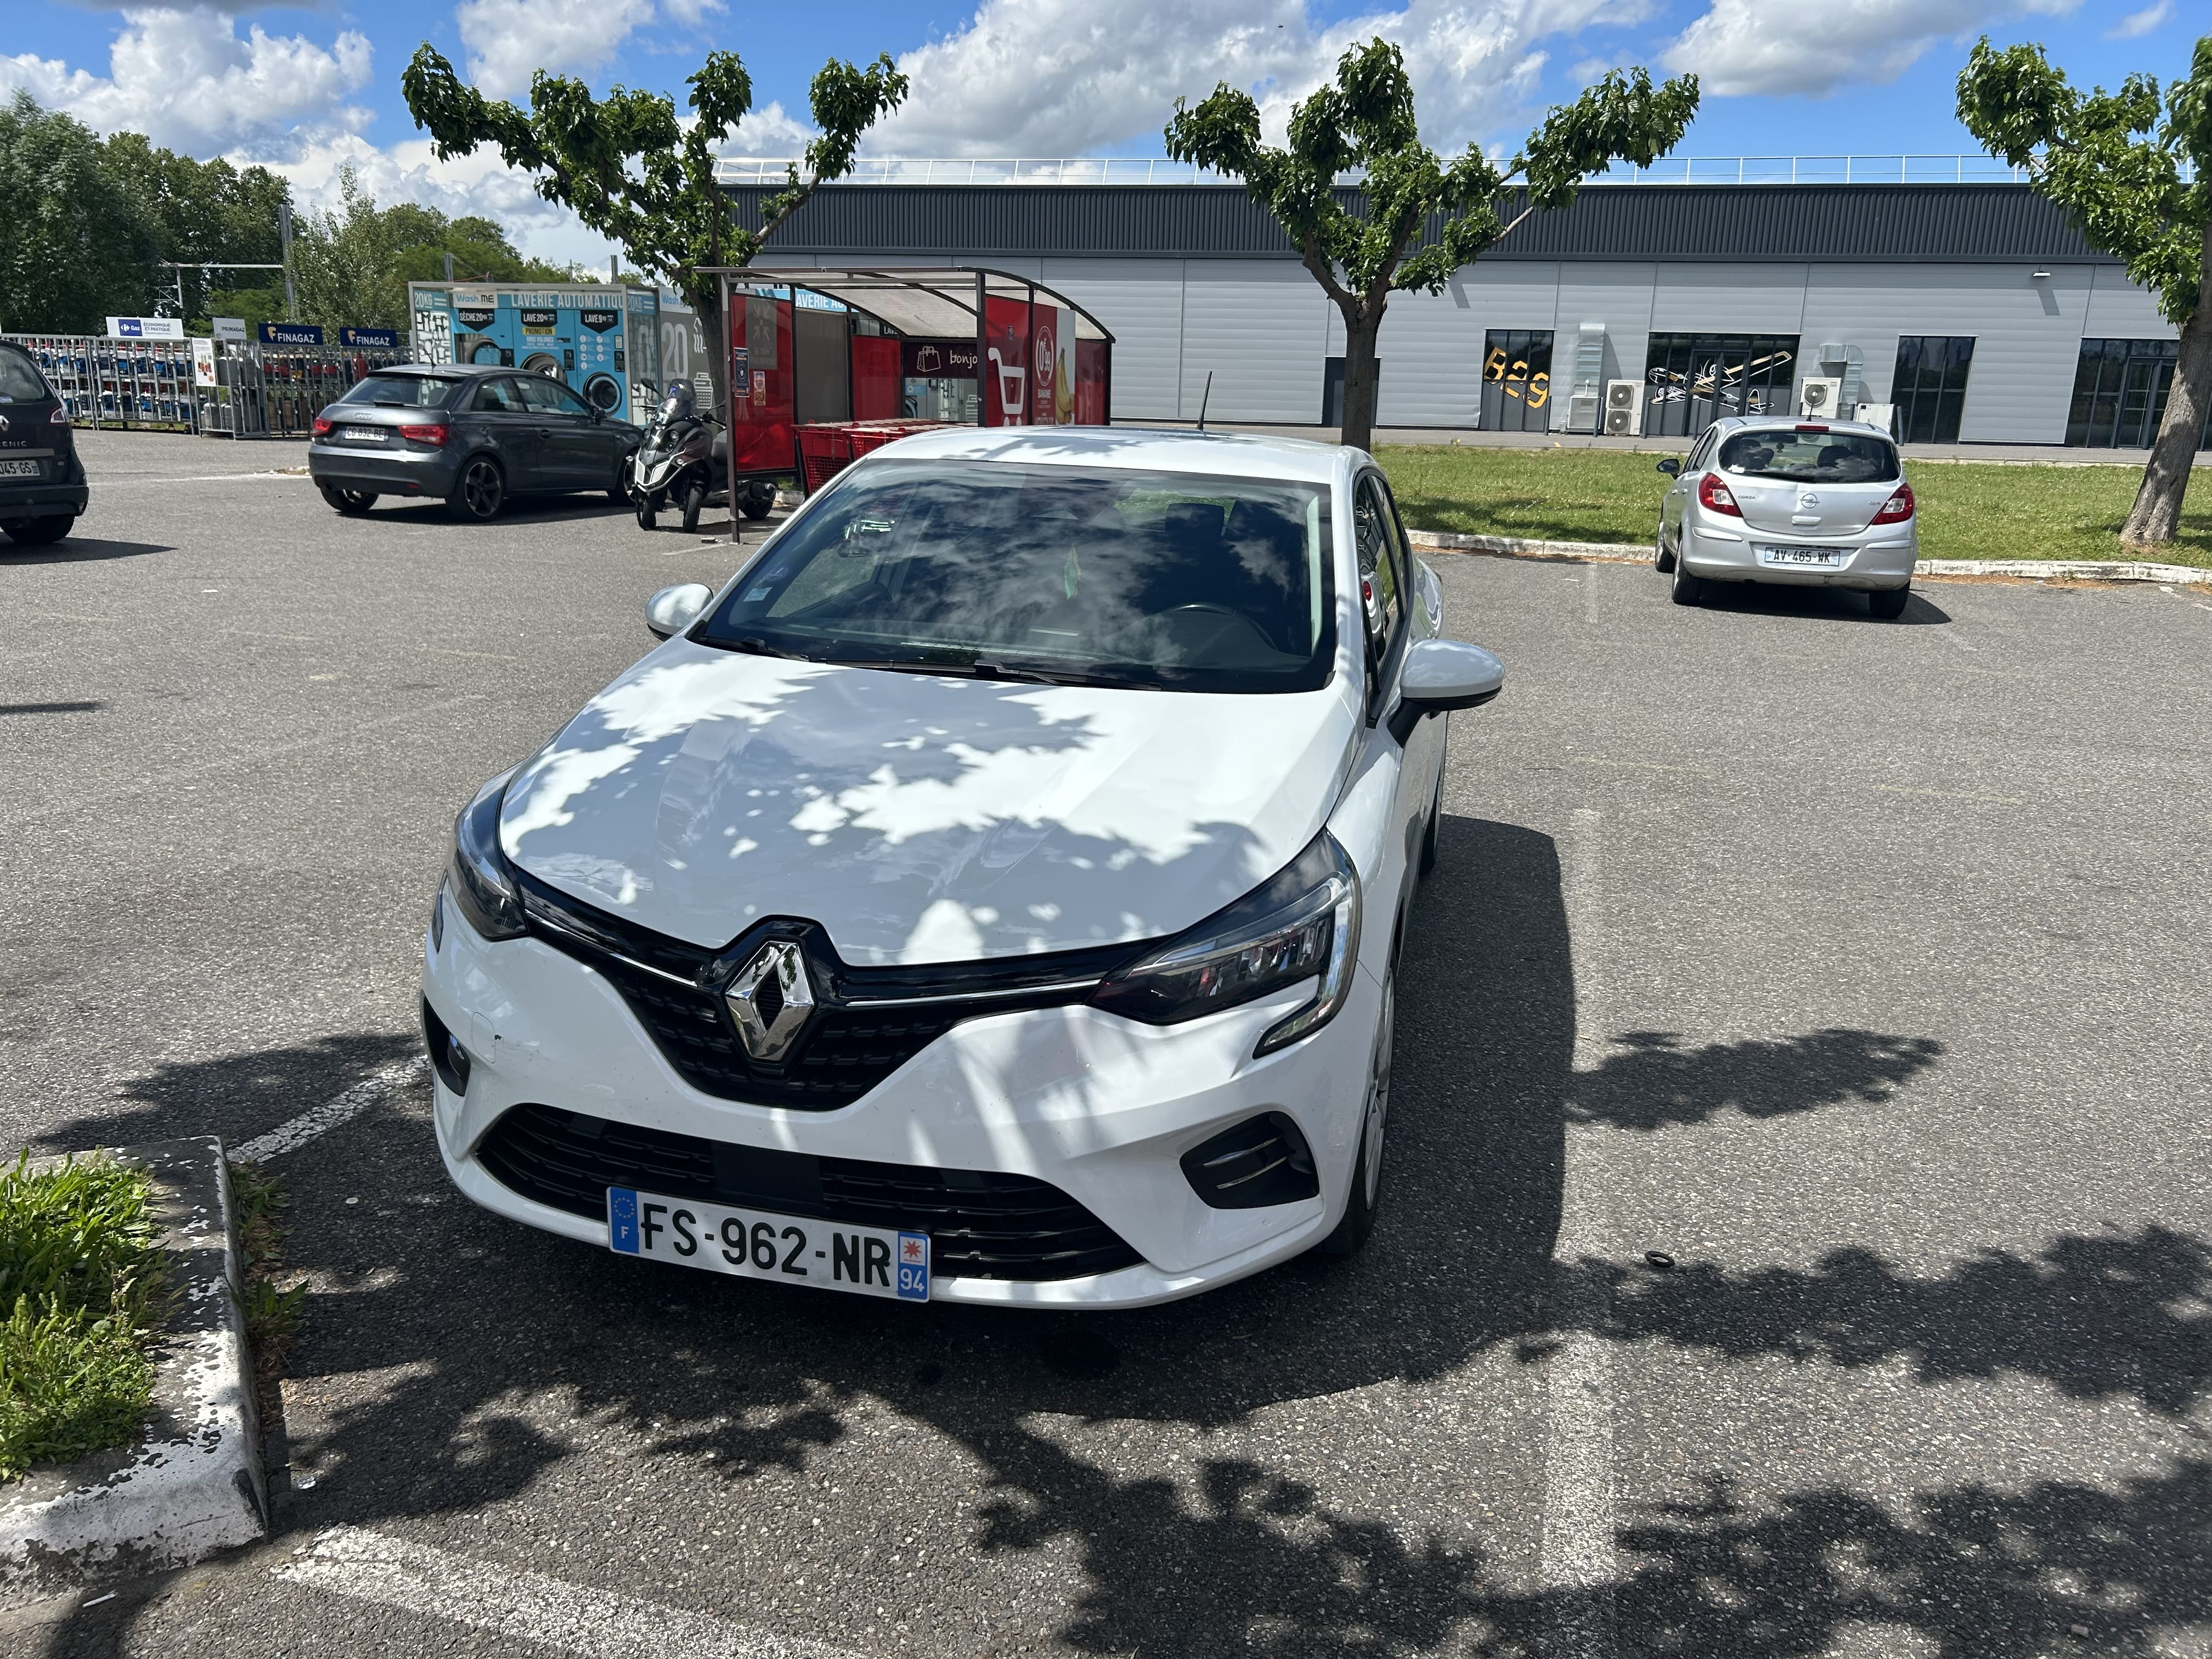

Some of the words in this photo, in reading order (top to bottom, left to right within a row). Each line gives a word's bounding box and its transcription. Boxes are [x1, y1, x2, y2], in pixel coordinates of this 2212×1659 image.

[511, 294, 554, 307] LAVERIE
[278, 332, 315, 343] FINAGAZ
[357, 336, 390, 346] FINAGAZ
[950, 350, 978, 369] bonjo
[1483, 346, 1549, 409] B29
[1773, 549, 1831, 564] AV-465-WK
[621, 1226, 629, 1239] F
[641, 1202, 891, 1288] FS-962-NR
[900, 1268, 925, 1293] 94
